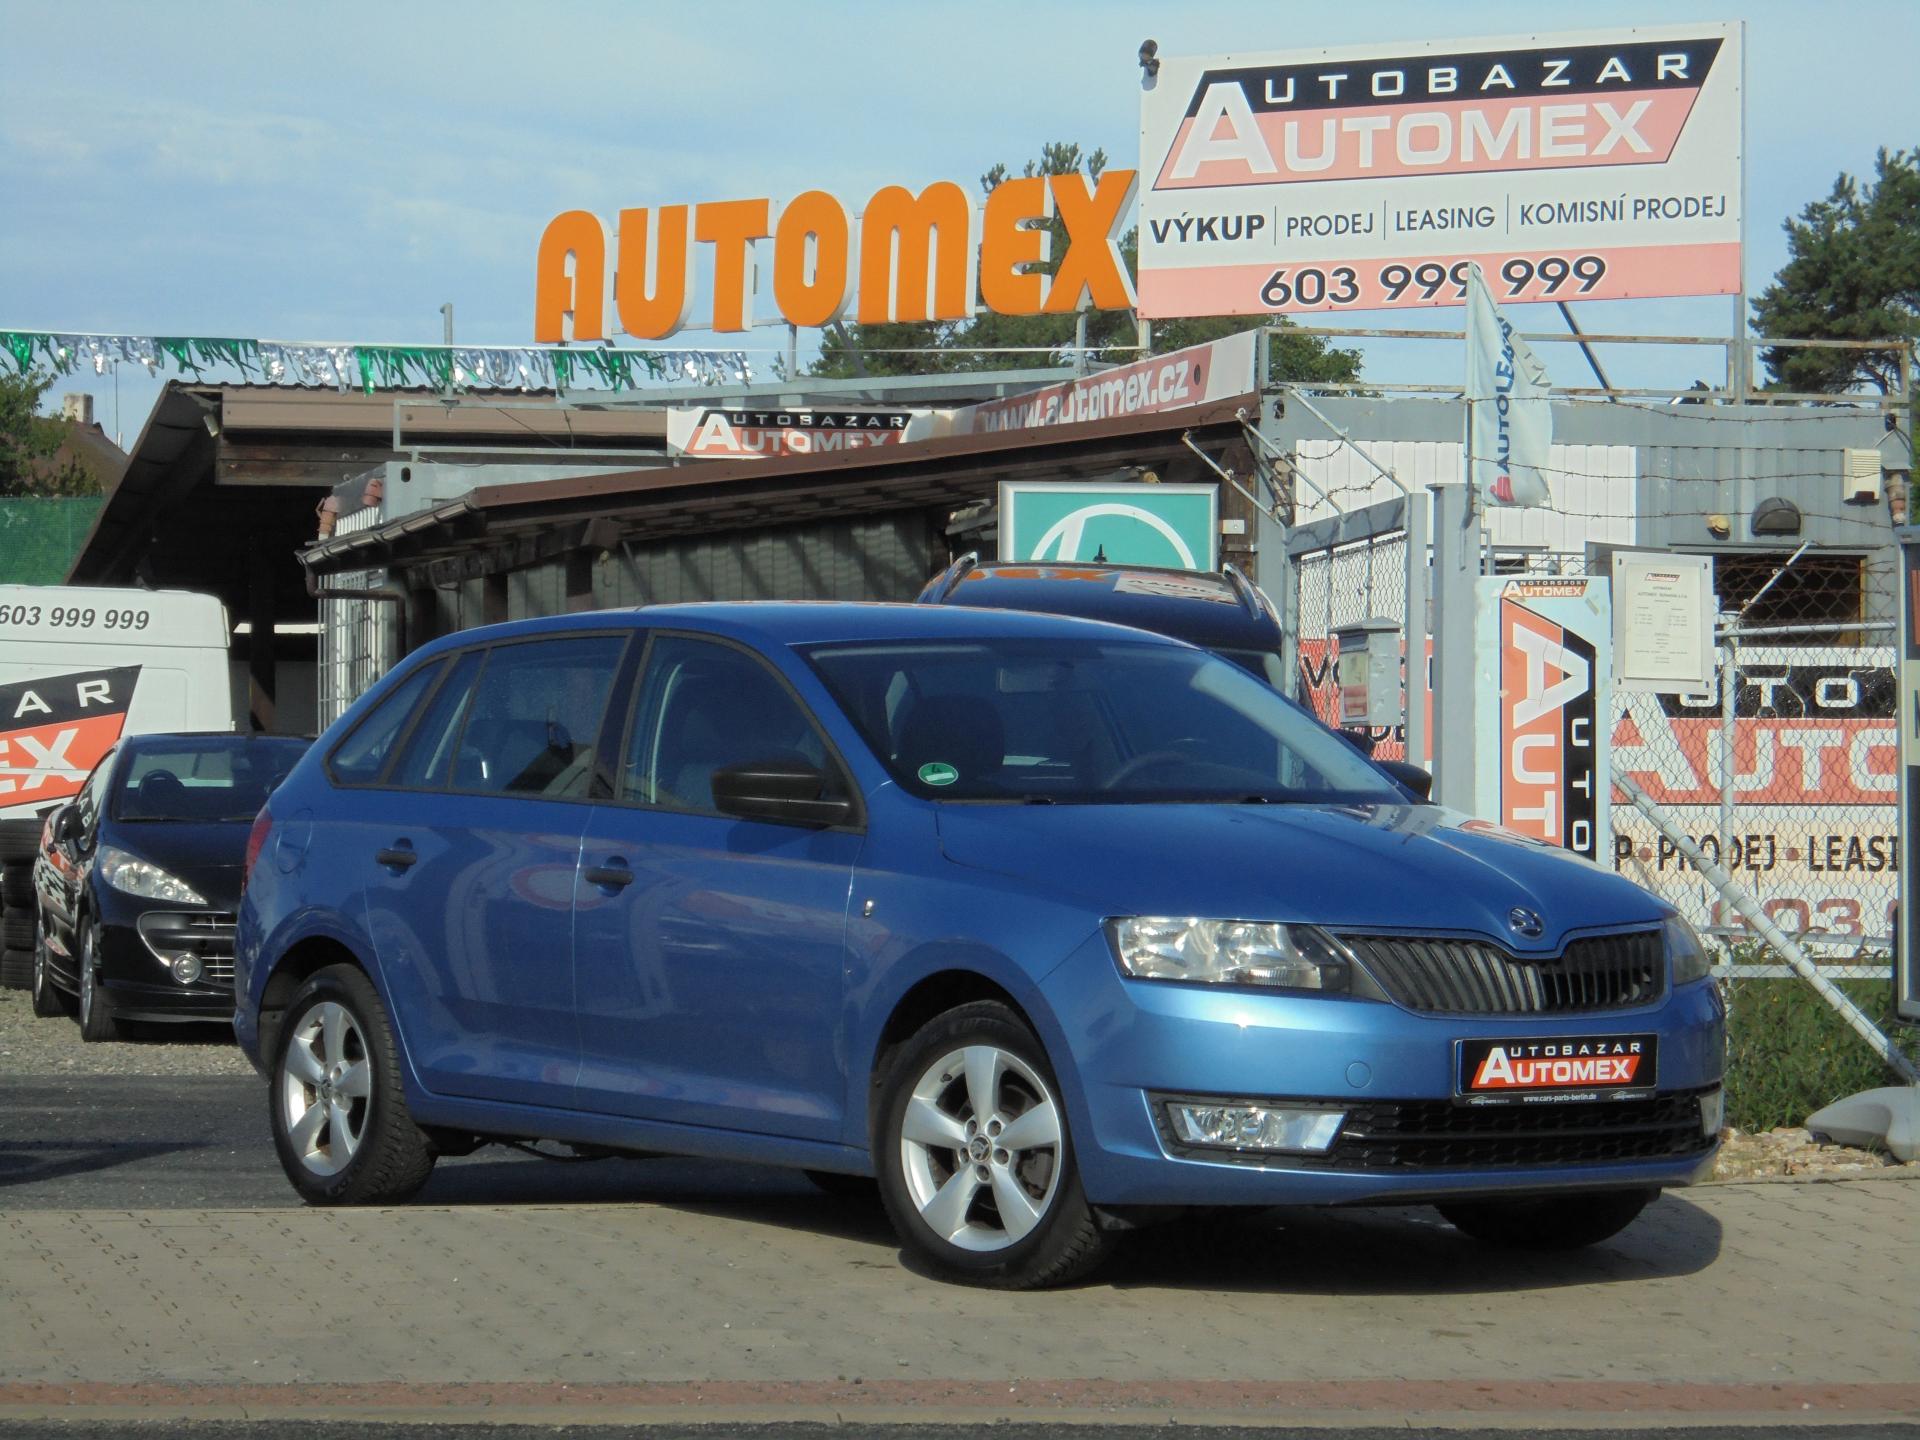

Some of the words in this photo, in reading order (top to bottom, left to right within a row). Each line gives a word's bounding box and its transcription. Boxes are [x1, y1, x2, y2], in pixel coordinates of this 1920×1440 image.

[1169, 81, 1653, 180] AUTOMEX
[1150, 212, 1265, 244] VÝKUP
[1286, 212, 1374, 238] PRODEJ
[1395, 205, 1495, 231] LEASING
[1519, 193, 1626, 226] KOMISNÍ
[1632, 195, 1726, 221] PRODEJ
[534, 168, 1138, 344] AUTOMEX
[1260, 267, 1361, 307] 603
[1500, 255, 1606, 296] 999
[694, 414, 889, 454] AUTOMEX
[1503, 580, 1582, 597] AUTOMEX
[50, 606, 96, 629] 999
[103, 609, 150, 631] 999
[1478, 1047, 1630, 1085] AUTOMEX
